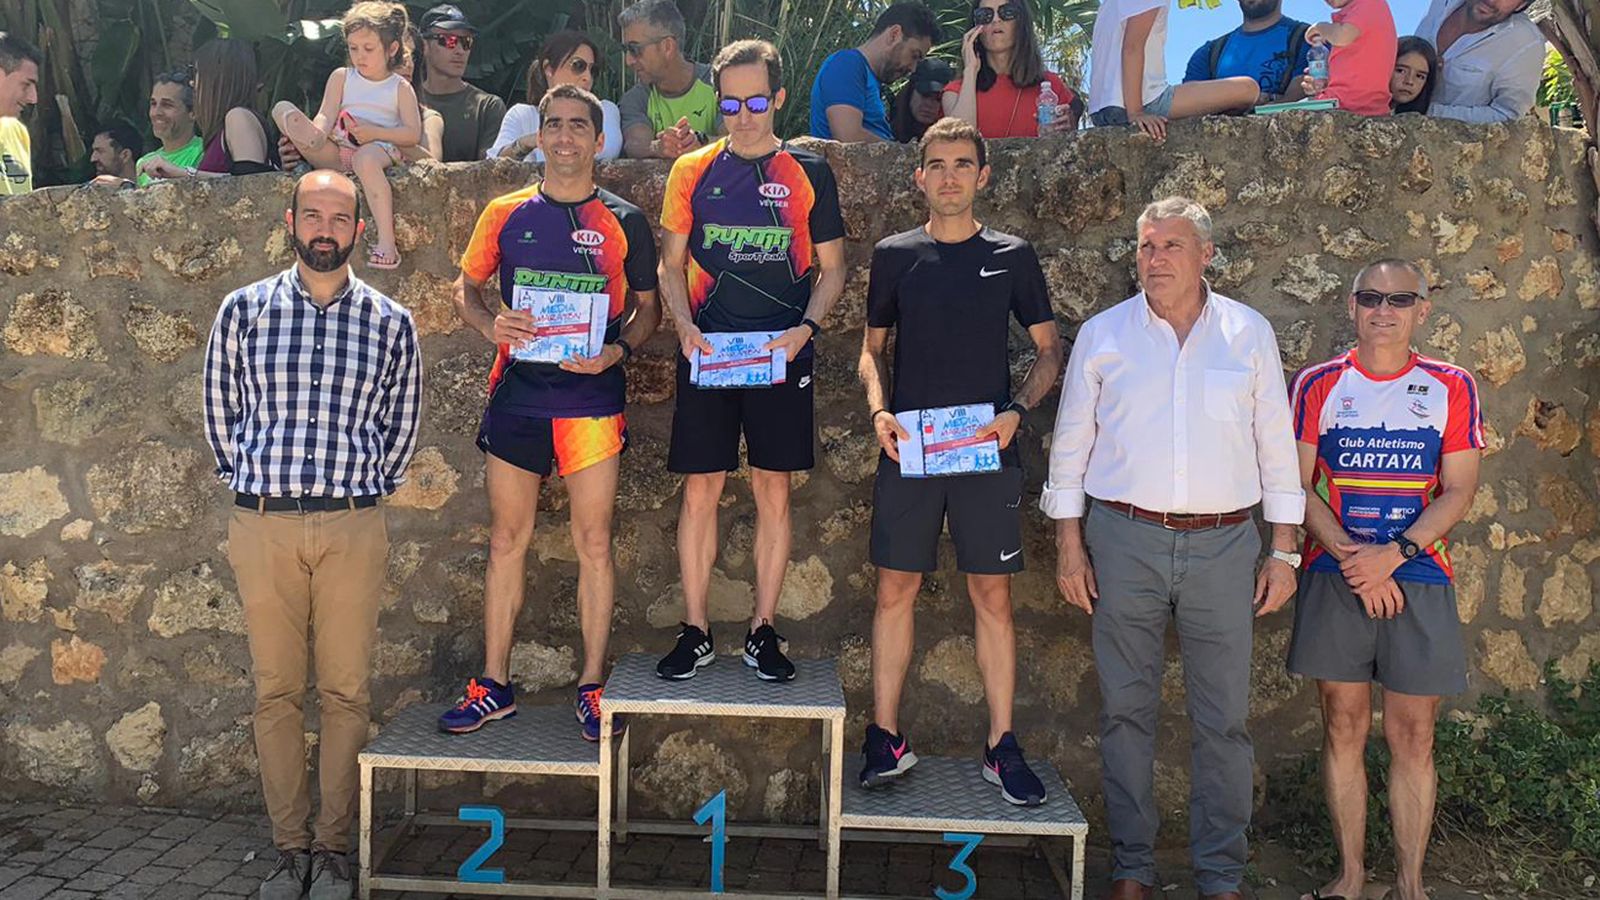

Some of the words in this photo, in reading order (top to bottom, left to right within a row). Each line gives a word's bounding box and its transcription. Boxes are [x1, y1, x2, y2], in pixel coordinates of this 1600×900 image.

[572, 245, 604, 256] VEYSER
[540, 303, 576, 315] MEDIA
[942, 414, 979, 430] MEDIA
[1338, 437, 1365, 448] Club
[1367, 437, 1425, 449] Atletismo
[1338, 452, 1422, 470] CARTAYA
[458, 805, 504, 883] 2
[692, 788, 726, 893] 1
[935, 832, 986, 900] 3
